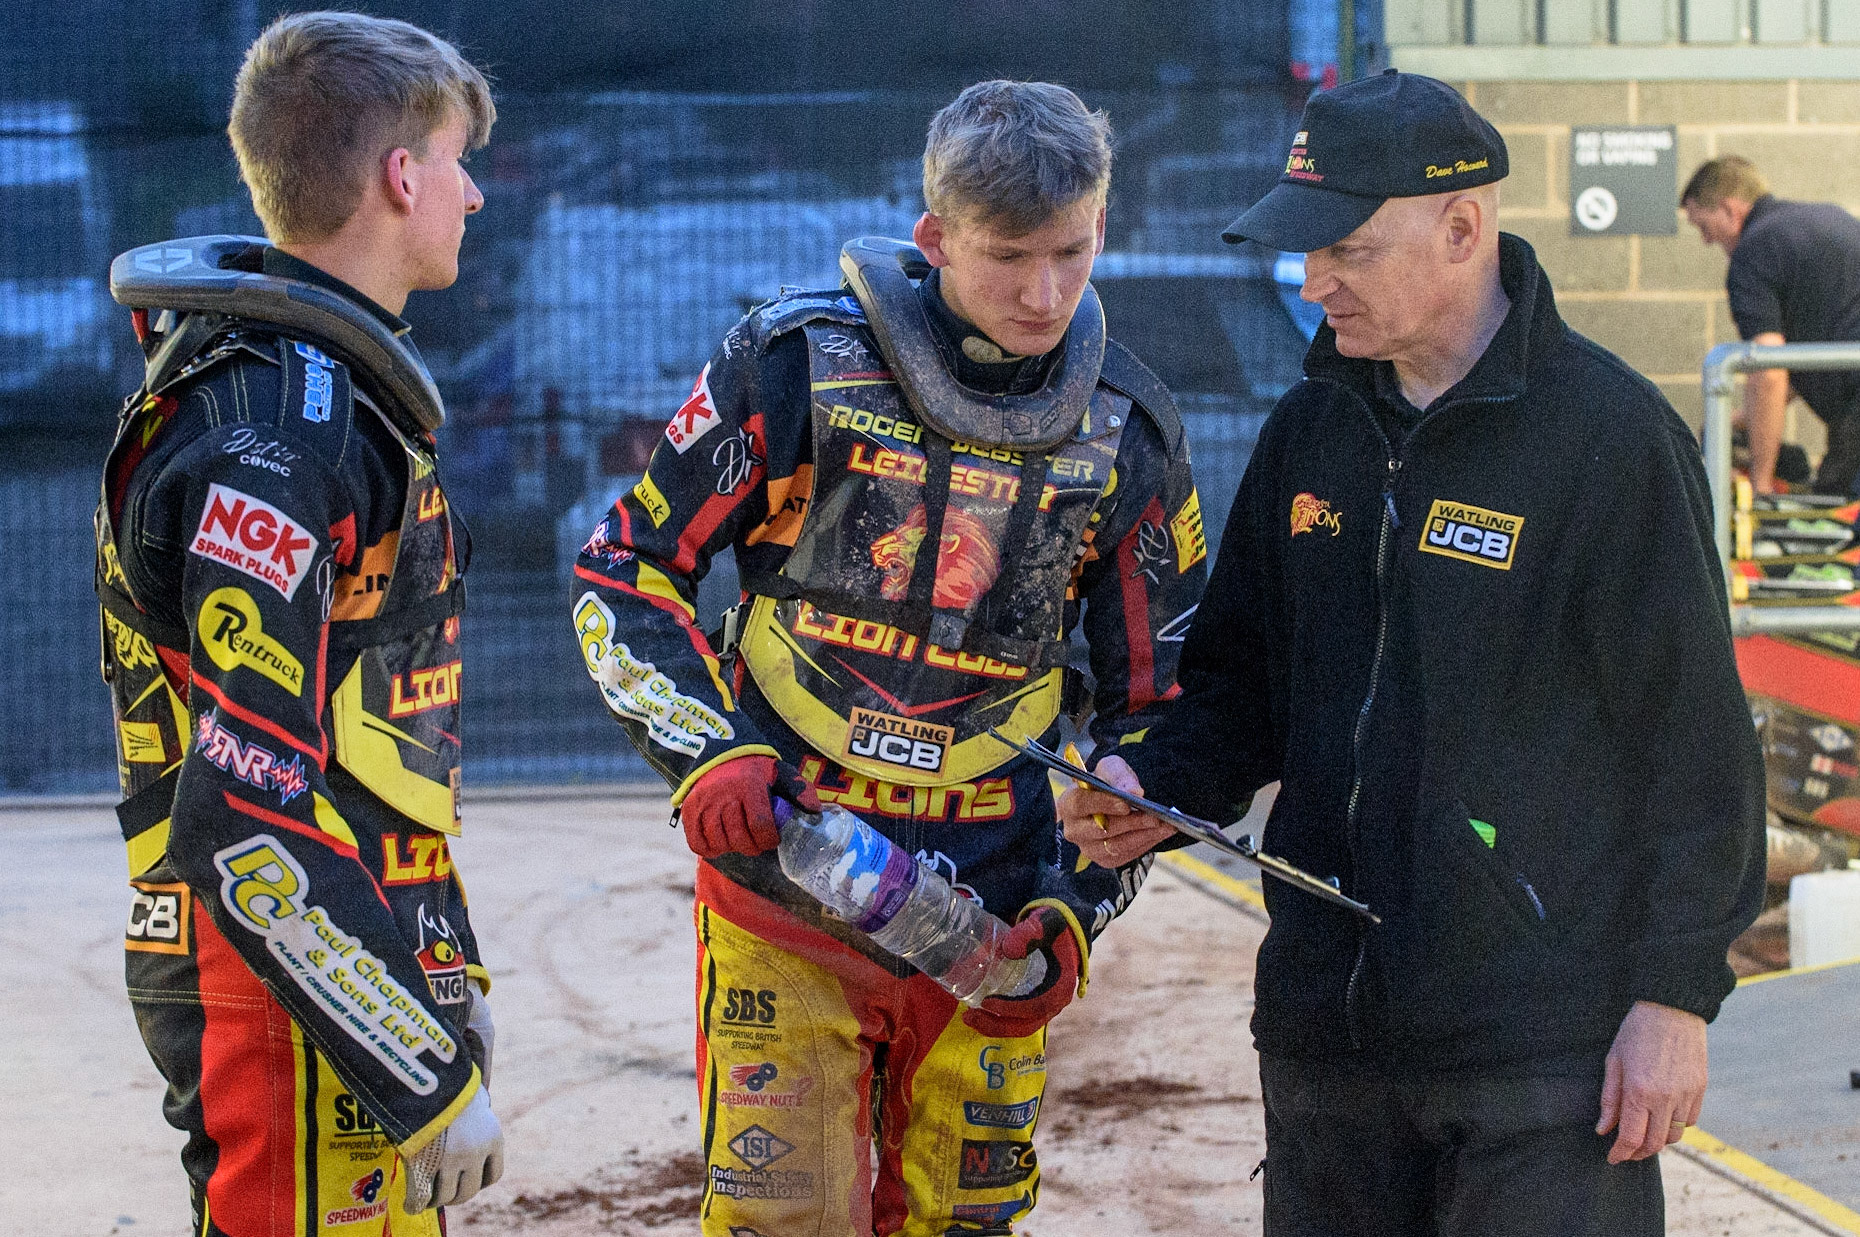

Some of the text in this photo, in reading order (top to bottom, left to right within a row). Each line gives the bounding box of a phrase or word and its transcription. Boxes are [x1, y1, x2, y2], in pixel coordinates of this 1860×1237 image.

[1426, 165, 1454, 178] Dave
[201, 492, 310, 578] NGK
[1439, 505, 1515, 532] WATLING
[1429, 521, 1511, 560] JCB
[196, 538, 289, 593] SPARK PLUGS
[213, 602, 300, 686] Rentruck
[610, 646, 653, 682] Paul
[857, 712, 948, 742] WATLING
[852, 731, 942, 770] JCB
[221, 843, 298, 929] PC
[127, 892, 178, 939] CB
[301, 909, 455, 1054] Paul Chapman
[307, 949, 424, 1050] & Sons Ltd
[274, 941, 306, 970] PLANT
[305, 974, 349, 1016] CRUSHER
[346, 1013, 371, 1035] HIRE
[368, 1033, 380, 1042] &
[377, 1041, 429, 1087] RECYCLING
[723, 987, 777, 1024] SBS
[717, 1029, 782, 1042] SUPPORTING BRITISH
[731, 1040, 765, 1051] SPEEDWAY
[1009, 1056, 1031, 1071] Colin
[720, 1091, 767, 1107] SPEEDWAY
[743, 1137, 774, 1159] ISI
[711, 1165, 767, 1183] Industrial
[712, 1178, 813, 1199] Inspections
[326, 1204, 377, 1225] SPEEDWAY
